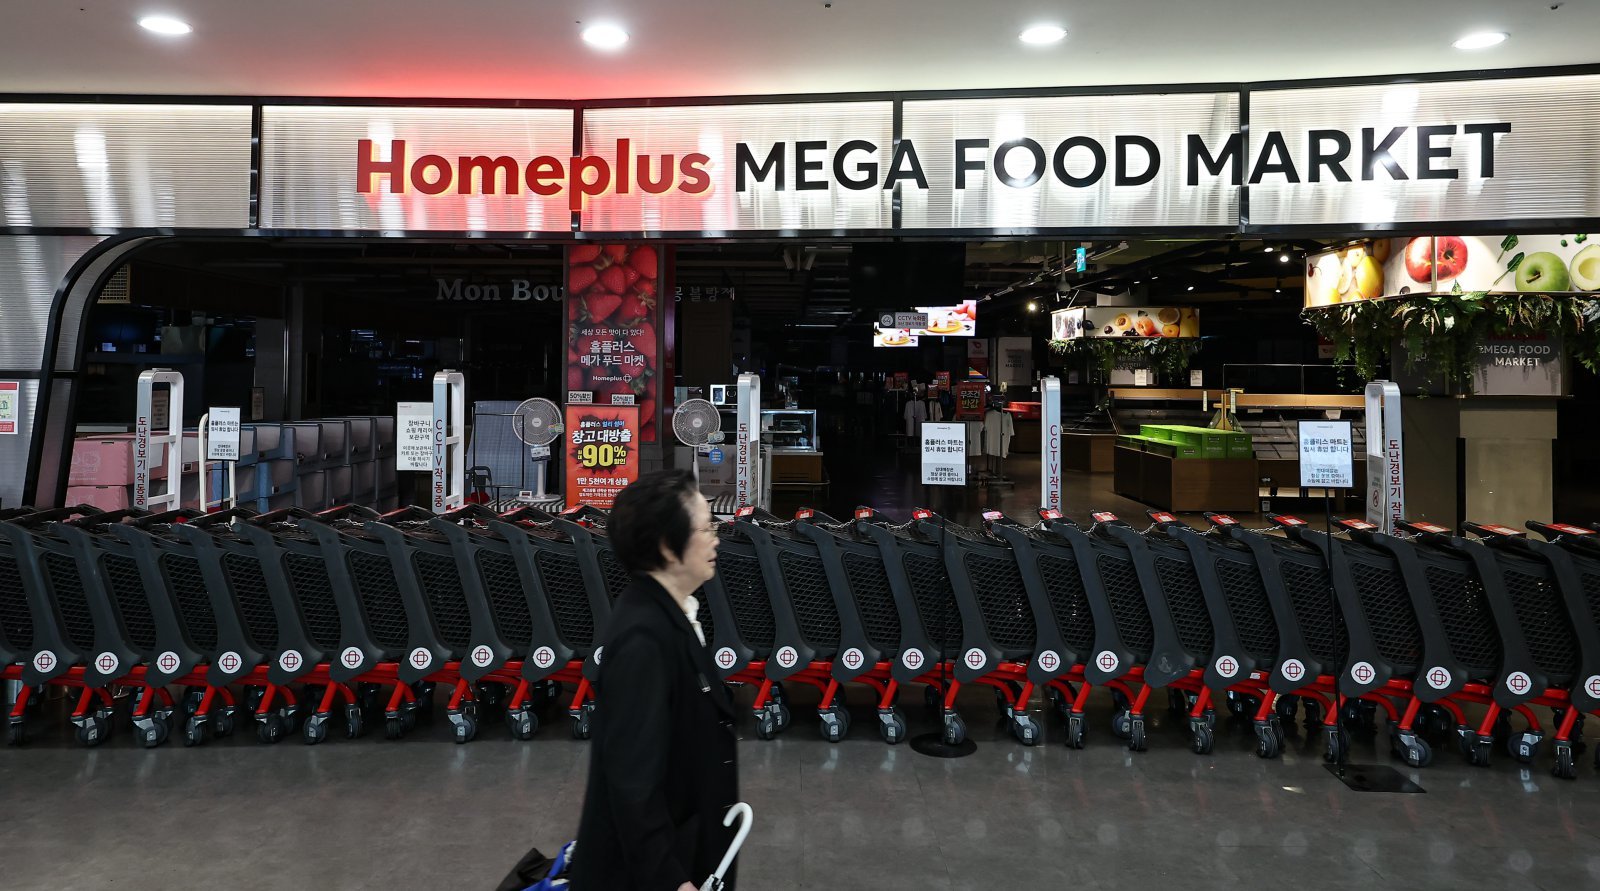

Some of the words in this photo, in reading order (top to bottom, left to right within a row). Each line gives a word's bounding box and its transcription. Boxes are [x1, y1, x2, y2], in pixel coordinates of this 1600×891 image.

[356, 138, 711, 212] Homeplus
[735, 138, 929, 192] MEGA
[954, 134, 1162, 190] FOOD
[1186, 121, 1512, 187] MARKET
[436, 278, 502, 301] Mon
[581, 328, 594, 336] 세상
[595, 328, 608, 336] 모든
[609, 328, 621, 336] 맛이
[622, 328, 629, 336] 다
[590, 340, 635, 353] 홈플러스
[1485, 345, 1516, 354] MEGA
[1519, 345, 1551, 354] FOOD
[580, 354, 601, 367] 메가
[602, 354, 623, 367] 푸드
[624, 354, 644, 367] 마켓
[1495, 357, 1541, 367] MARKET
[592, 375, 623, 383] Homeplus
[960, 390, 981, 399] 무조건
[572, 429, 595, 444] 창고
[597, 429, 632, 443] 대방출
[925, 438, 946, 446] 홈플러스
[947, 438, 964, 446] 마트는
[1303, 438, 1329, 446] 홈플러스
[1329, 438, 1348, 446] 마트는
[136, 417, 147, 470] 도난경보기
[582, 443, 627, 467] 90%
[738, 423, 748, 478] 도난경보기
[1388, 439, 1401, 499] 도난경보기
[577, 477, 587, 485] 1만
[615, 477, 628, 486] 상품
[135, 473, 145, 505] 작동중
